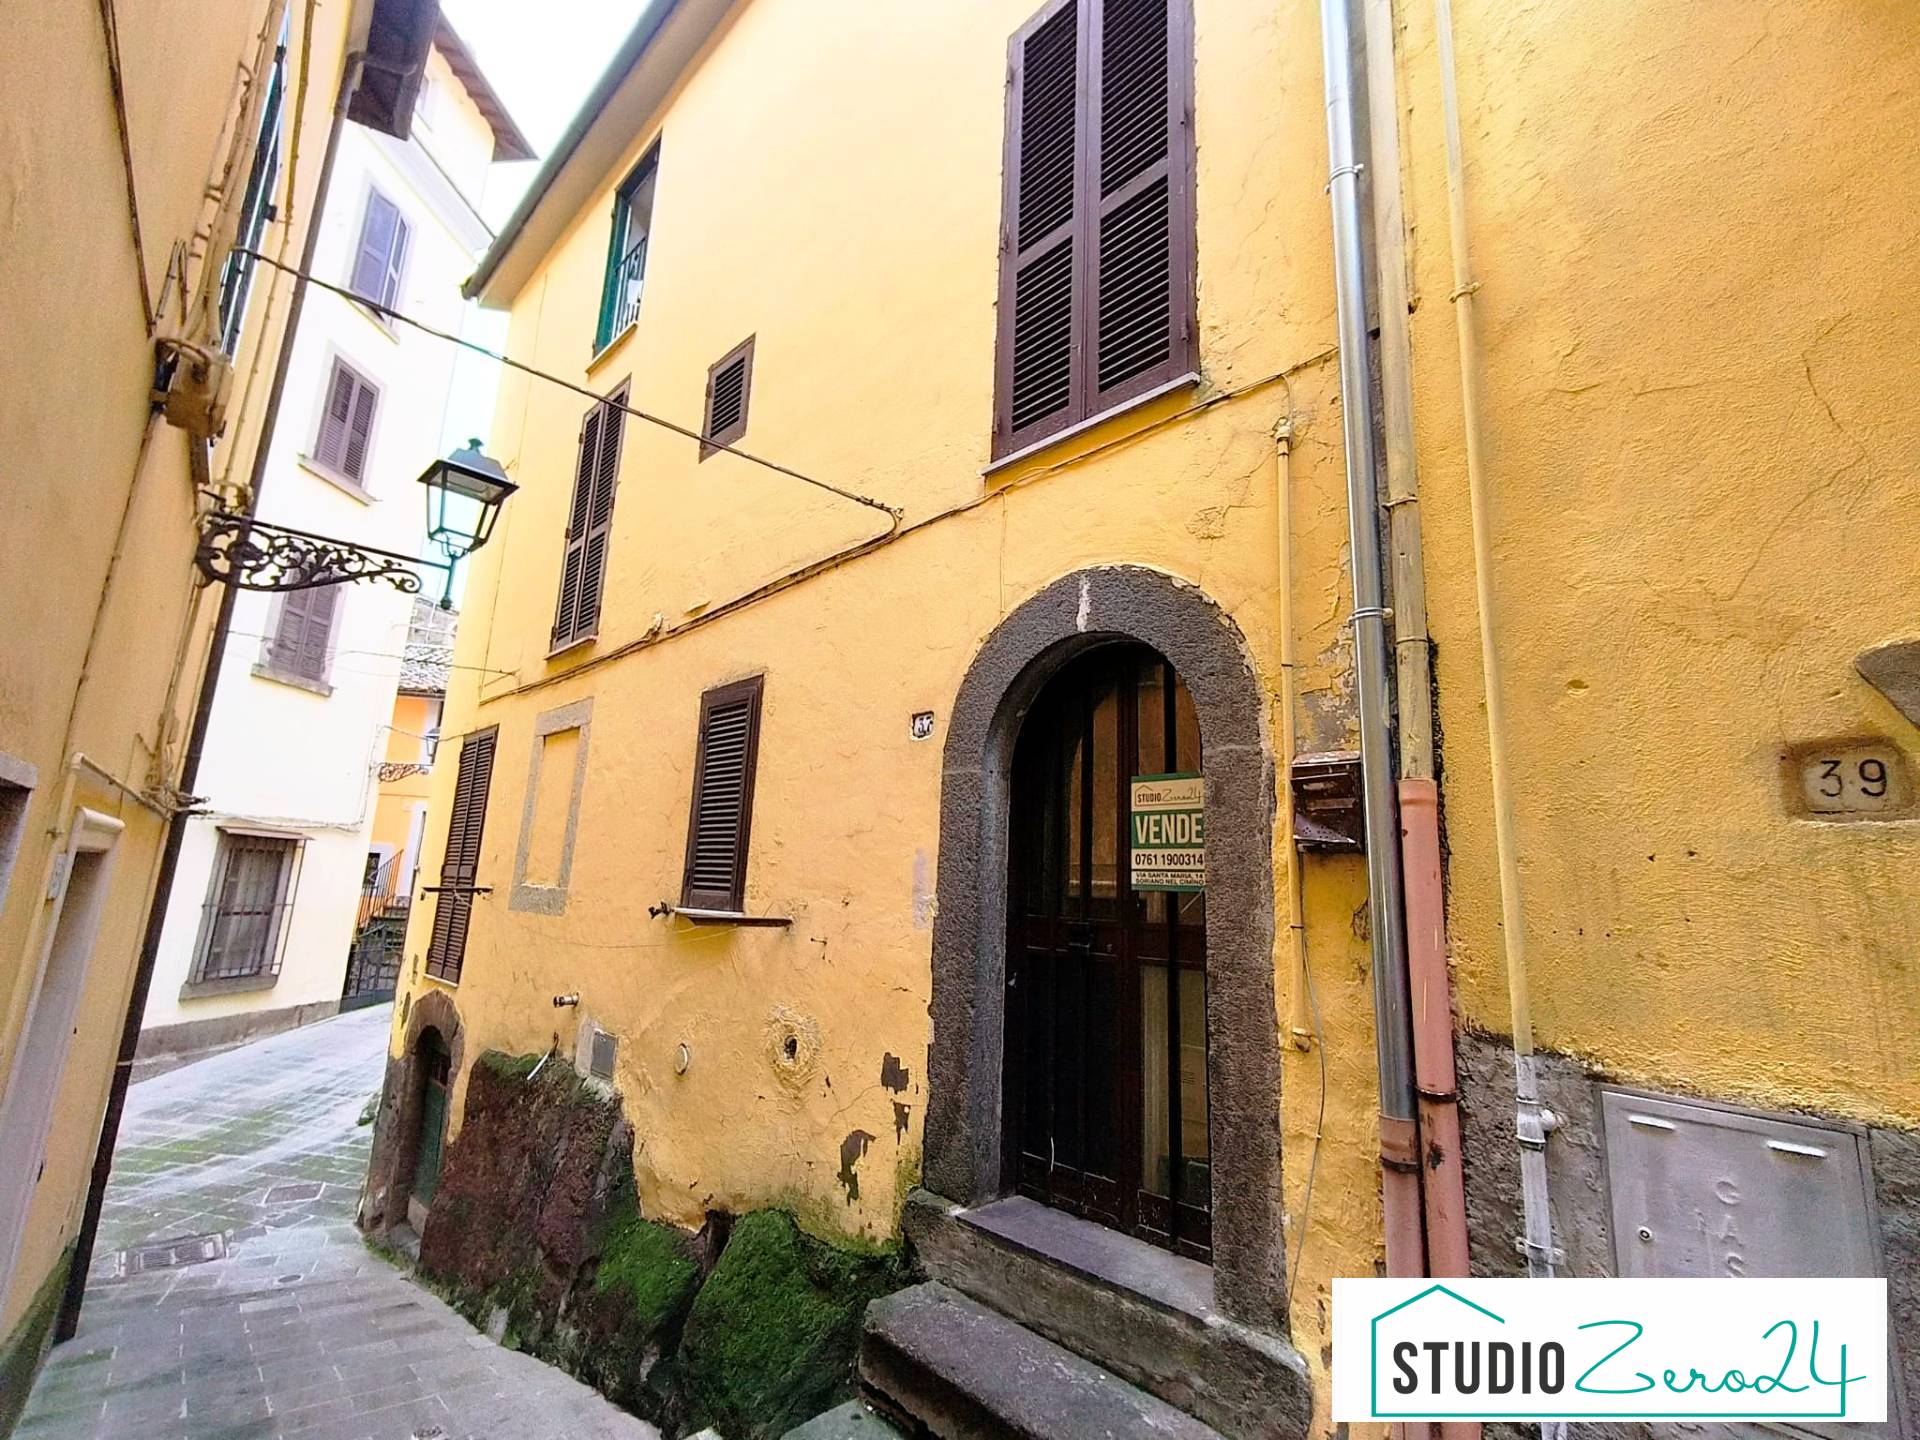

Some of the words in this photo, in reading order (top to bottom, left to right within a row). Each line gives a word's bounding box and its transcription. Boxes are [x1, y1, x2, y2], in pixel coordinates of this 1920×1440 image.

[1820, 759, 1887, 797] 39
[1137, 792, 1161, 803] STUDIO
[1135, 813, 1203, 844] VENDE
[1135, 853, 1158, 866] 0761
[1161, 853, 1204, 866] 1900314
